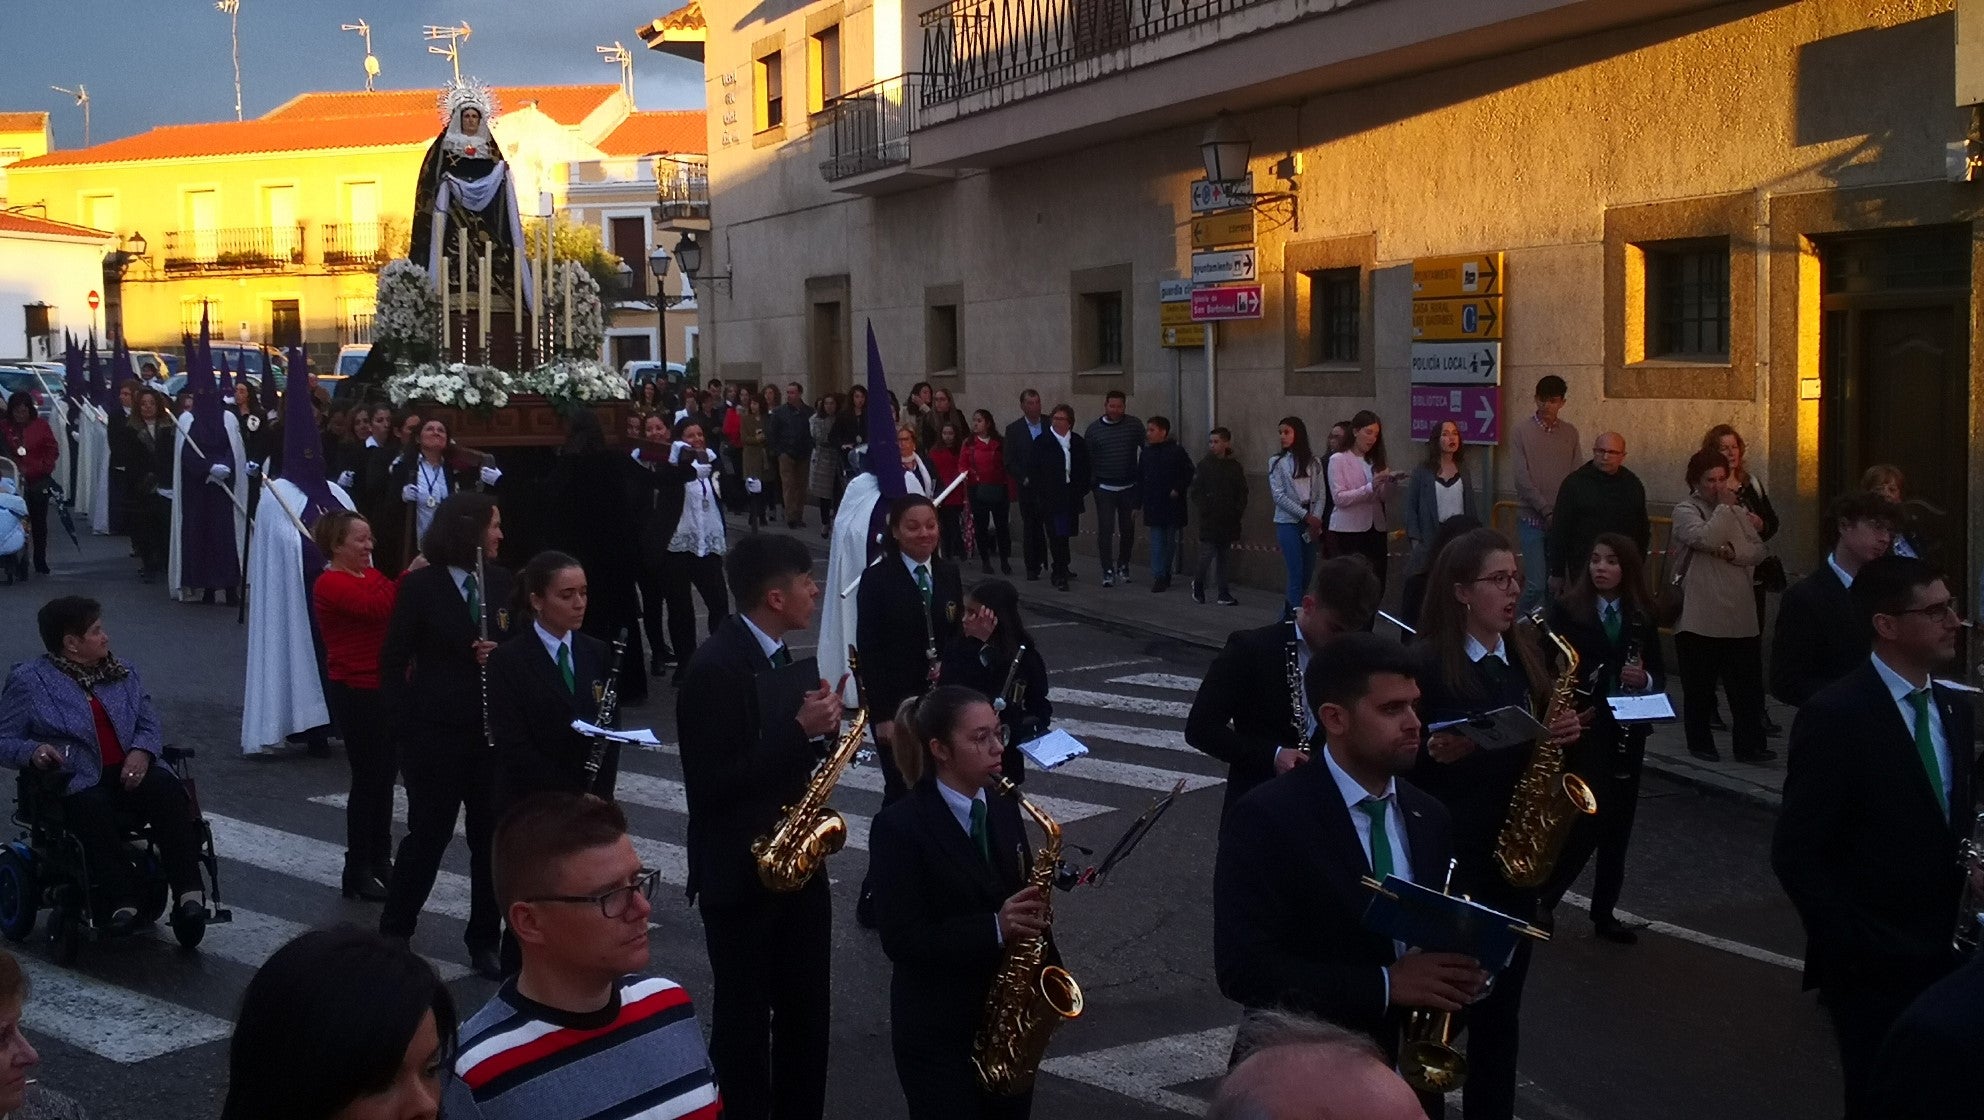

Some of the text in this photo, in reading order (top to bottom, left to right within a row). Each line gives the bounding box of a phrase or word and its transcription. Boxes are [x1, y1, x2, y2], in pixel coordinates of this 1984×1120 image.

[1194, 262, 1233, 275] ayuntamiento
[1162, 284, 1183, 299] guardia
[1194, 305, 1205, 314] San
[1413, 354, 1468, 370] POLICÍA LOCAL
[1413, 395, 1448, 406] BIBLIOTECA
